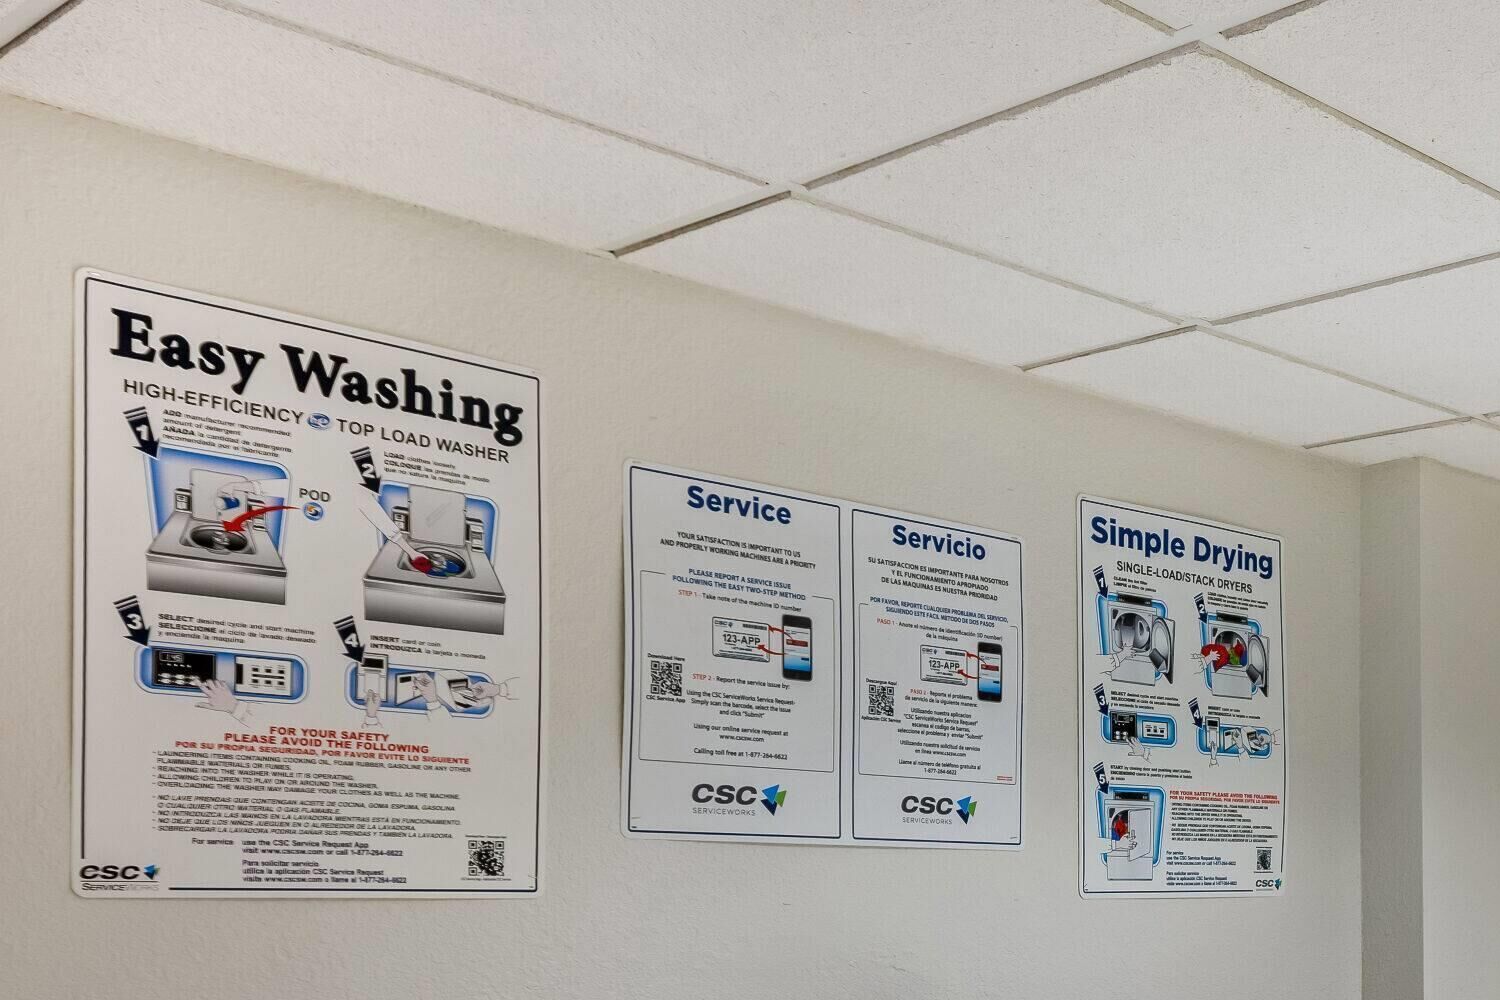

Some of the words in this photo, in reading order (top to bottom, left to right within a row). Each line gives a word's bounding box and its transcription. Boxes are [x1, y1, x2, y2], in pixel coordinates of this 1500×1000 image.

[111, 308, 265, 396] Easy
[280, 343, 524, 446] Washing
[123, 378, 304, 424] HIGH-EFFICIENCY
[336, 418, 374, 437] TOP
[381, 427, 430, 447] LOAD
[436, 438, 509, 463] WASHER
[136, 424, 148, 441] 1
[361, 463, 376, 478] 2
[299, 487, 331, 503] POD
[687, 485, 791, 524] Service
[676, 530, 695, 540] YOUR
[696, 534, 740, 547] SATISFACTION
[747, 543, 782, 554] IMPORTANT
[783, 548, 791, 556] TO
[792, 550, 801, 558] US
[892, 525, 986, 560] Servicio
[1091, 516, 1185, 558] Simple
[1194, 535, 1272, 580] Drying
[659, 537, 674, 546] AND
[675, 540, 707, 551] PROPERLY
[709, 546, 738, 556] WORKING
[739, 551, 771, 562] MACHINES
[772, 556, 783, 564] ARE
[789, 559, 816, 569] PRIORITY
[688, 568, 712, 577] PLEASE
[714, 572, 739, 581] REPORT
[746, 577, 772, 586] SERVICE
[773, 581, 791, 589] ISSUE
[877, 557, 918, 570] SATISFACCION
[927, 566, 963, 578] IMPORTANTE
[964, 573, 979, 581] PARA
[979, 575, 1009, 586] NOSOTROS
[1117, 561, 1214, 587] SINGLE-LOAD/STACK
[1217, 578, 1252, 594] DRYERS
[672, 575, 712, 586] FOLLOWING
[728, 583, 743, 591] EASY
[745, 585, 777, 596] TWO-STEP
[778, 590, 806, 600] METHOD
[890, 577, 901, 585] LAS
[902, 579, 933, 590] MAQUINAS
[942, 586, 967, 596] NUESTRA
[968, 590, 998, 601] PRIORIDAD
[904, 571, 955, 585] FUNCIONAMIENTO
[956, 580, 989, 591] APROPIADO
[1099, 578, 1104, 587] 1
[1199, 604, 1205, 613] 2
[125, 613, 143, 630] 3
[345, 632, 358, 647] 4
[723, 633, 761, 645] 123-APP
[929, 660, 960, 670] 123-APP
[716, 675, 735, 683] Report
[1099, 696, 1105, 705] 3
[1193, 709, 1199, 719] 4
[224, 732, 276, 744] PLEASE
[281, 736, 321, 747] AVOID
[326, 739, 351, 748] THE
[356, 741, 429, 753] FOLLOWING
[269, 726, 296, 735] FOR
[301, 728, 336, 738] YOUR
[341, 730, 389, 741] SAFETY
[175, 740, 197, 748] POR
[217, 743, 255, 751] PROPIA
[258, 745, 318, 755] SEGURIDAD,
[344, 750, 375, 758] FAVOR
[378, 752, 404, 760] EVITE
[422, 755, 469, 764] SIGUIENTE
[1099, 774, 1105, 784] 5
[692, 783, 757, 805] CSC
[692, 807, 756, 816] SERVICEWORKS
[901, 795, 953, 815] CSC
[902, 816, 952, 825] SERVICEWORKS
[1256, 879, 1273, 887] CSC
